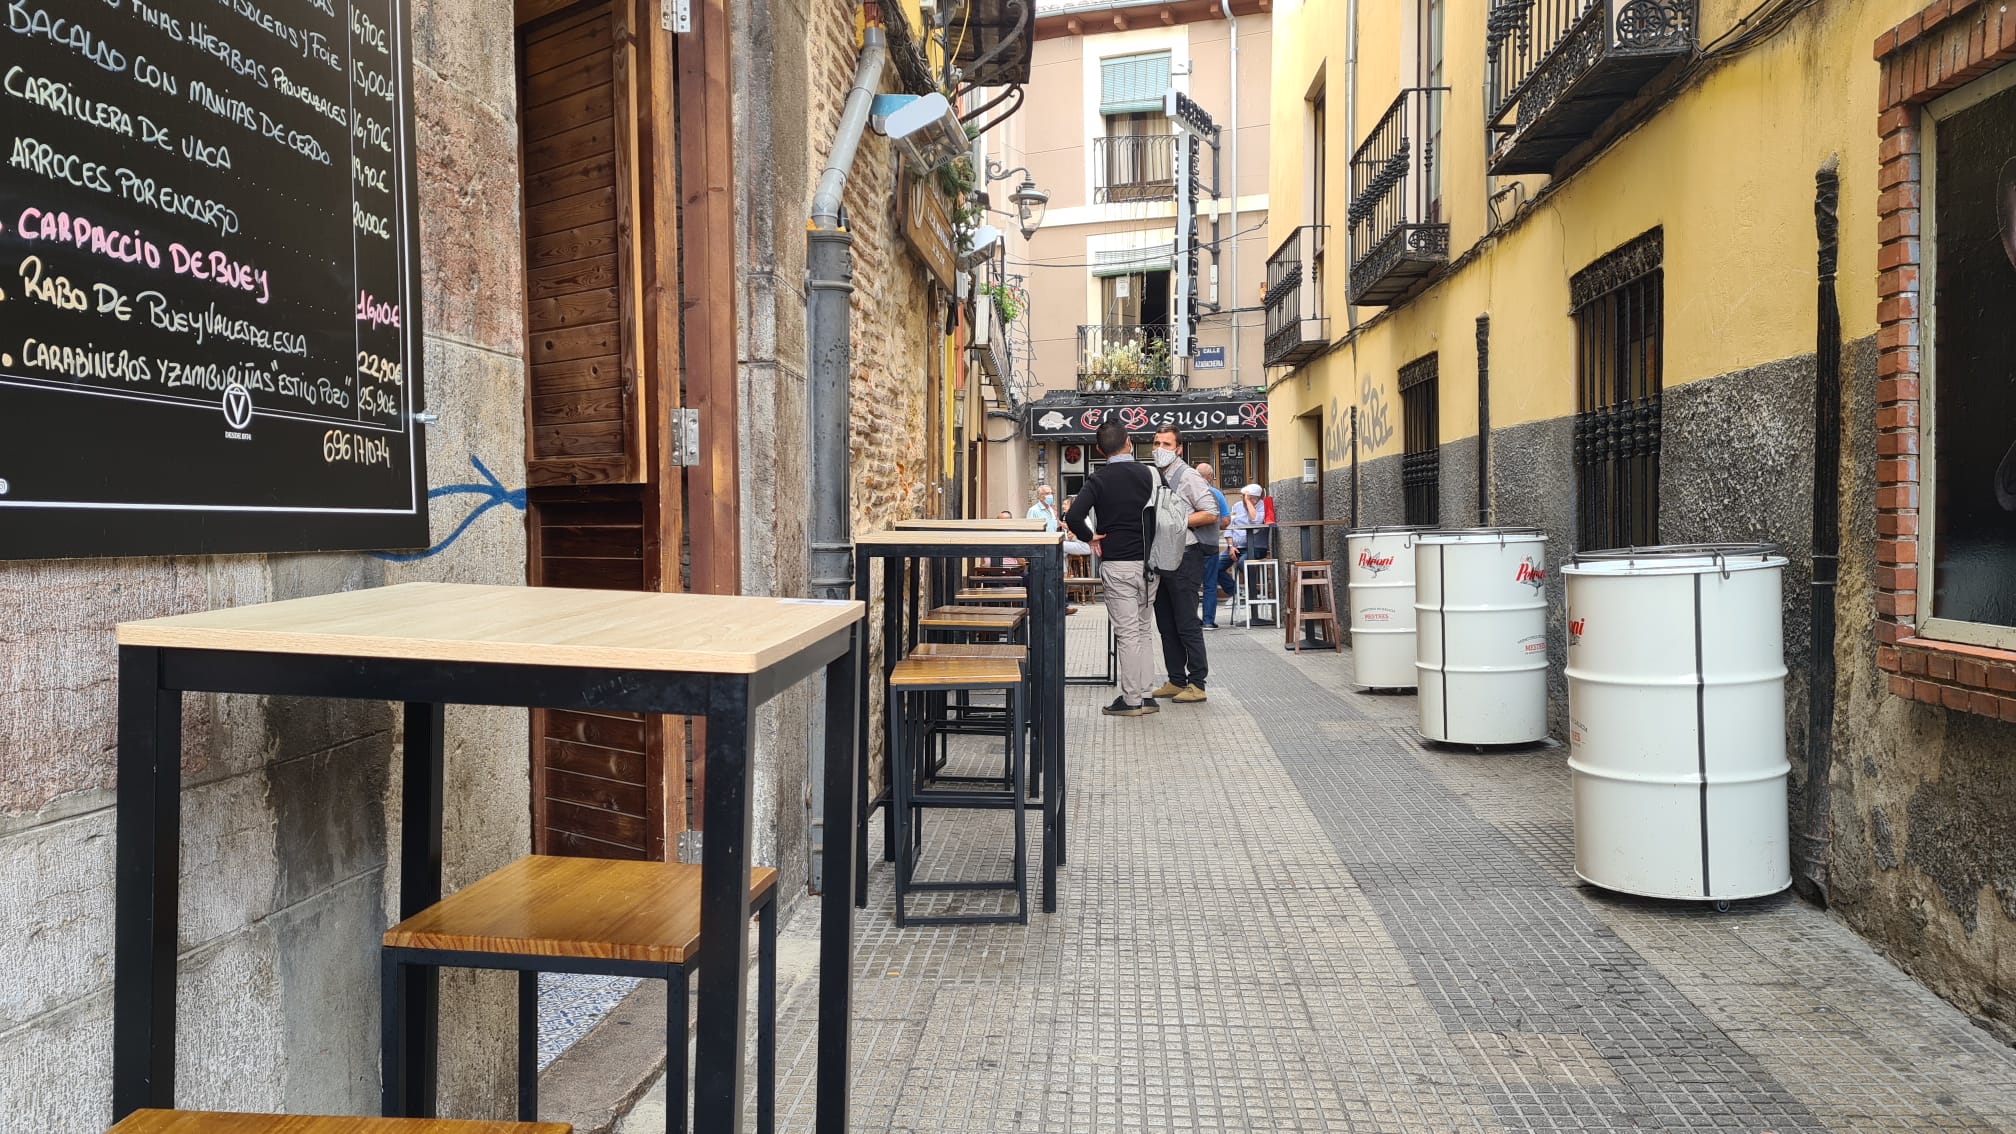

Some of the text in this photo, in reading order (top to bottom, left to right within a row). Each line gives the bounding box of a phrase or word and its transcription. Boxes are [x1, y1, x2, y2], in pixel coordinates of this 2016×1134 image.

[135, 56, 177, 95] CON
[260, 112, 286, 144] DE
[137, 116, 172, 150] DE
[10, 137, 111, 192] ARROCES
[115, 168, 158, 208] POR
[19, 256, 87, 310] RABO
[93, 283, 132, 320] DE
[1119, 406, 1225, 430] Besugo
